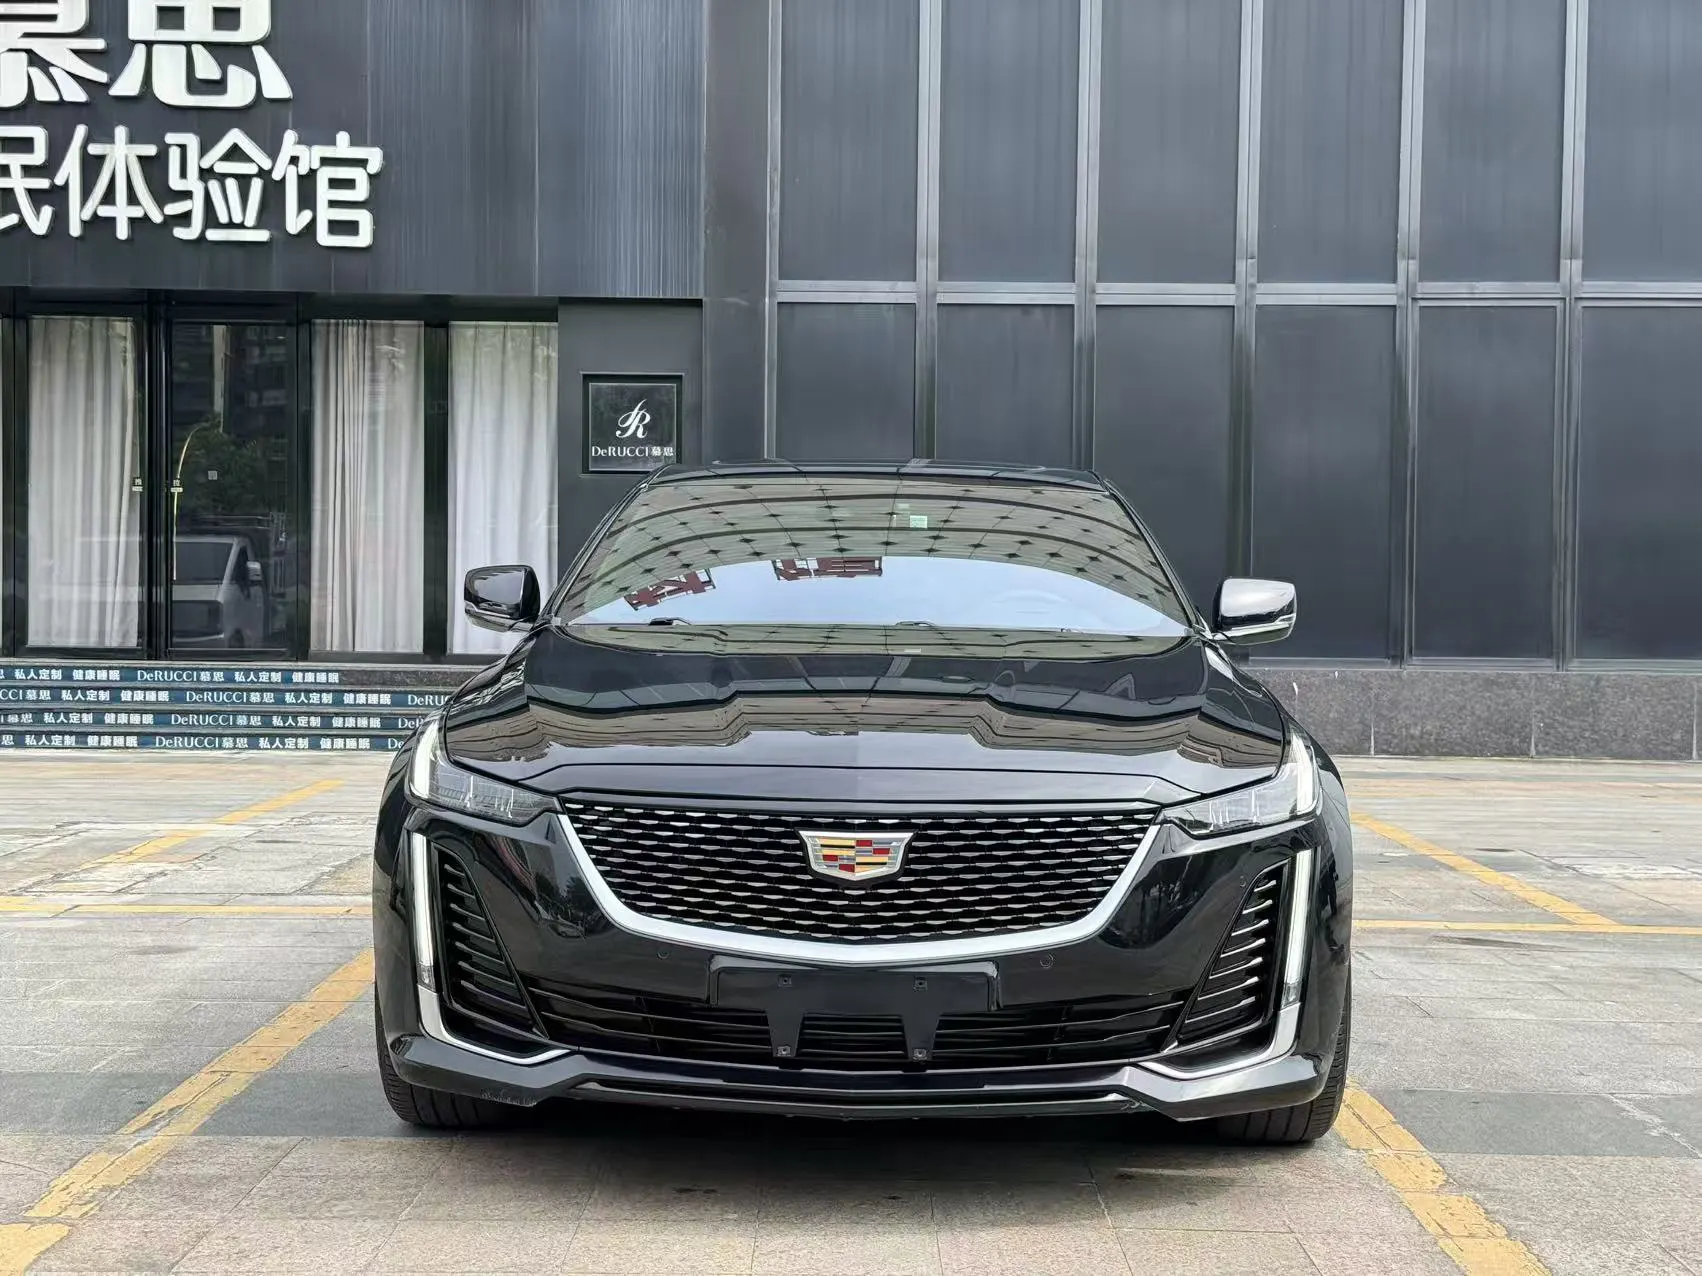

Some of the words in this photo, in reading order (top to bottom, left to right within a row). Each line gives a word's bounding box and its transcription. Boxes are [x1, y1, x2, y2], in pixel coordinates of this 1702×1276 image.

[591, 446, 649, 457] DeRUCCI
[14, 668, 63, 680] 私人定制
[136, 670, 197, 682] DeRUCCI
[234, 671, 282, 683] 私人定制
[61, 690, 110, 702] 私人定制
[186, 691, 247, 703] DeRUCCI
[284, 692, 333, 704] 私人定制
[43, 712, 94, 724] 私人定制
[171, 713, 233, 726] DeRUCCI
[271, 715, 321, 728] 私人定制
[24, 734, 76, 747] 私人定制
[155, 735, 219, 748] DeRUCCI
[258, 737, 309, 749] 私人定制
